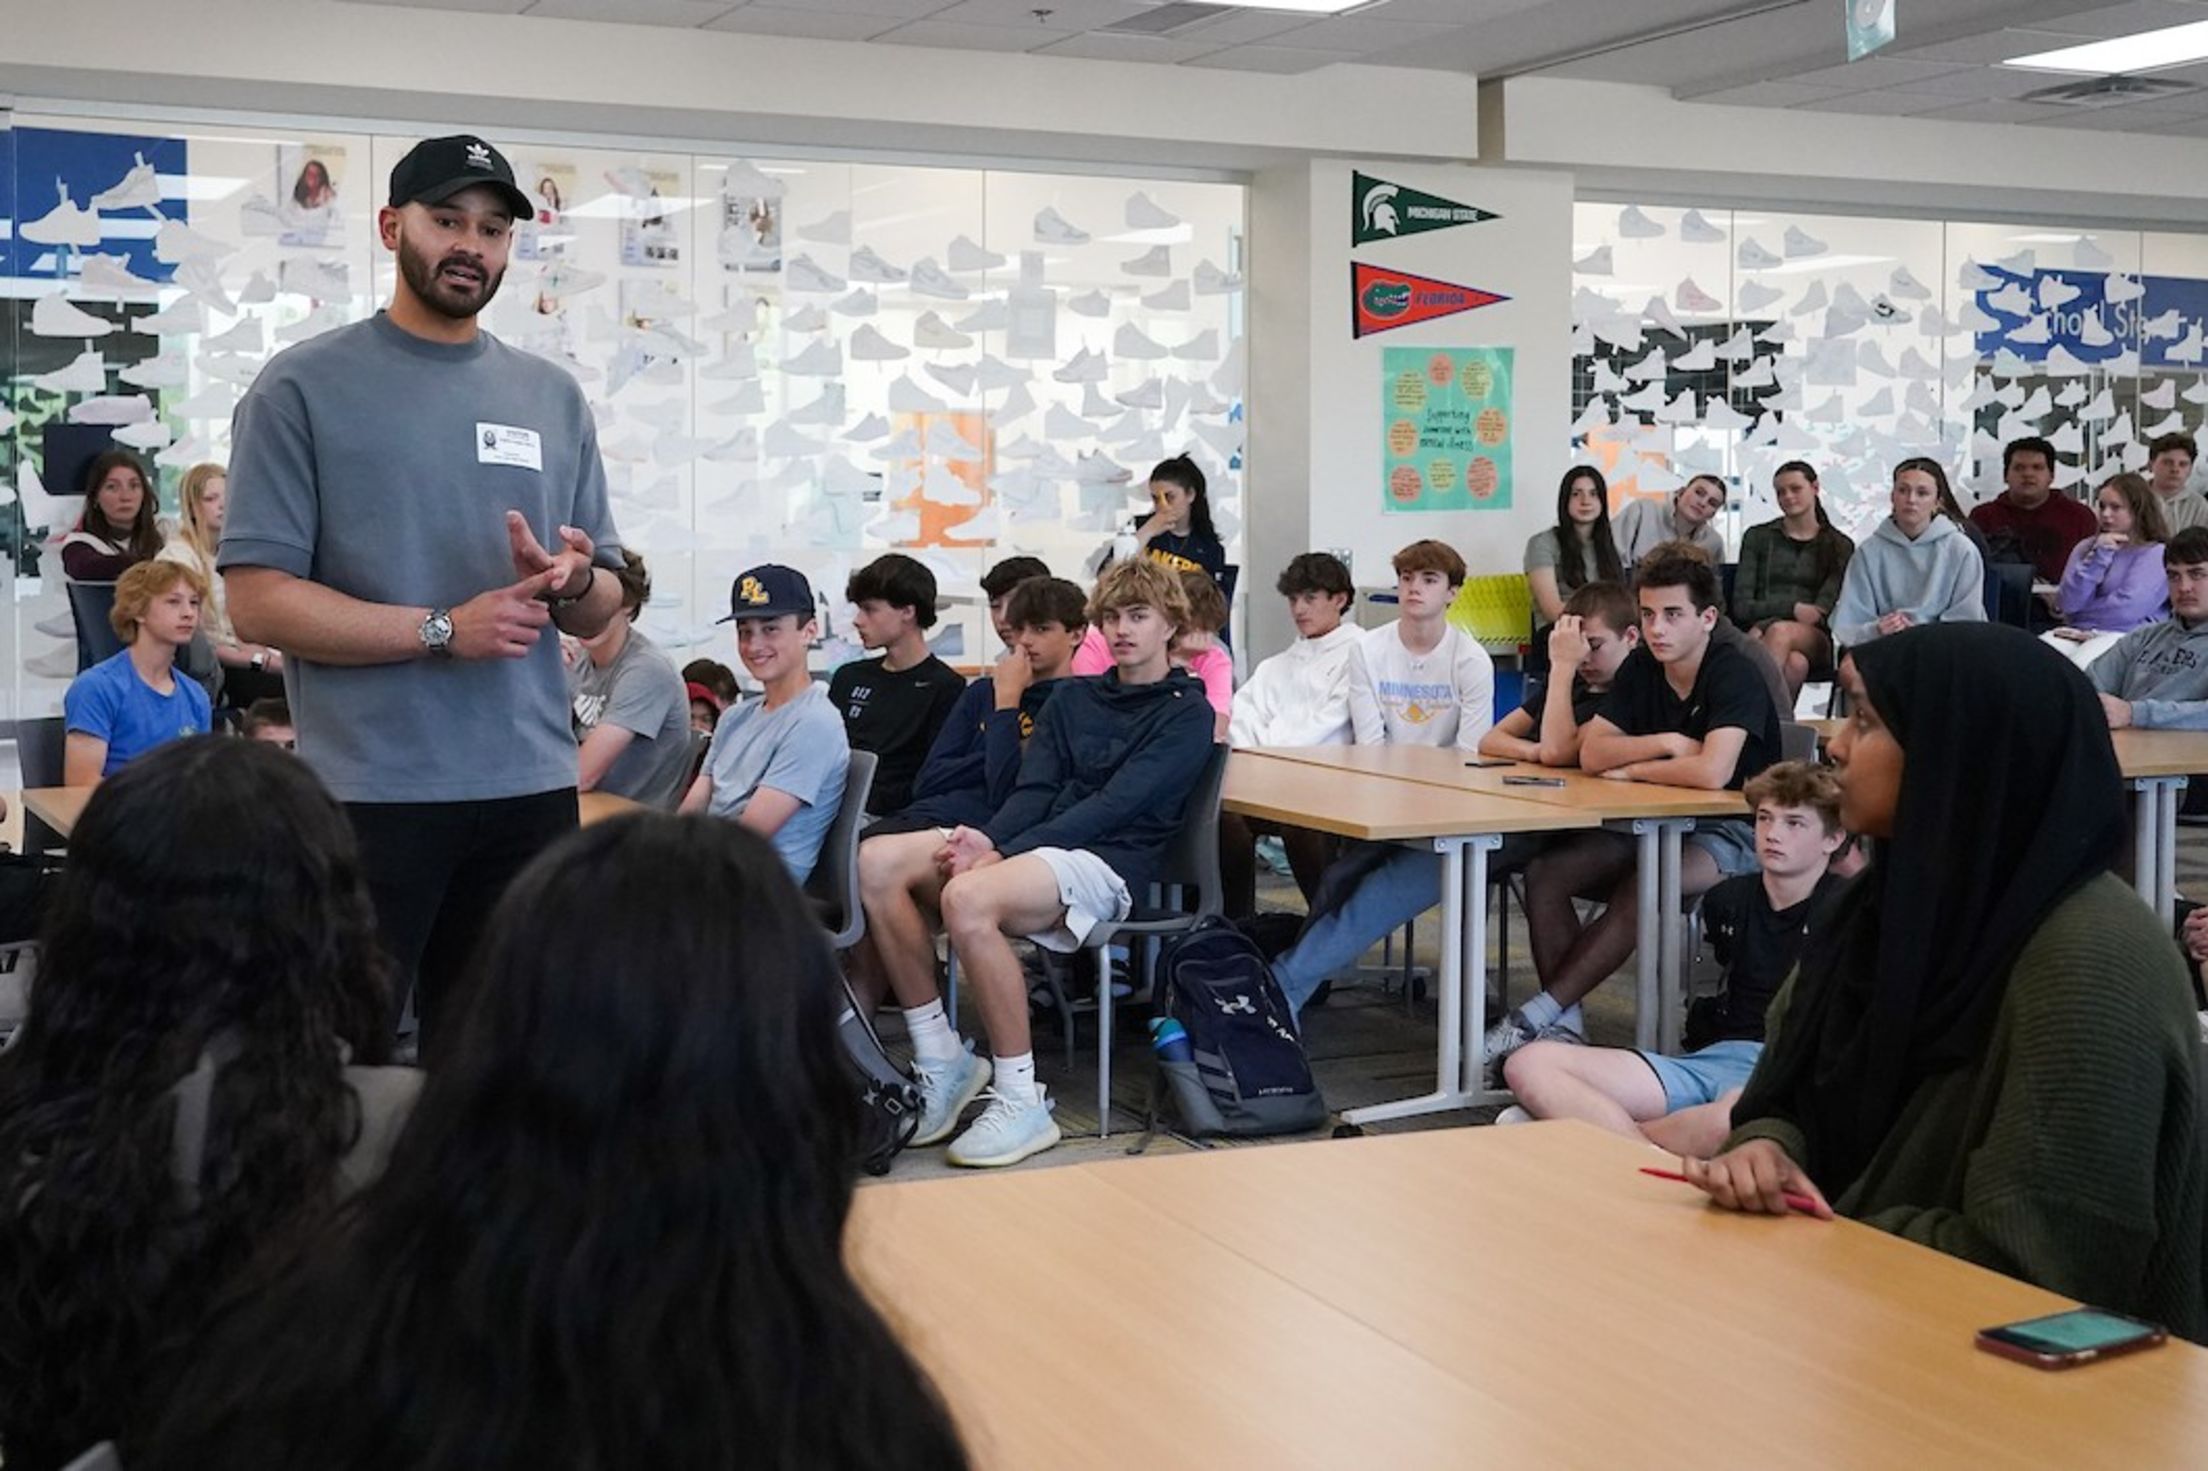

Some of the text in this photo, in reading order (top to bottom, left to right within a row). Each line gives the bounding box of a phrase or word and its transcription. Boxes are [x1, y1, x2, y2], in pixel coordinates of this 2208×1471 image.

[1407, 206, 1479, 222] MICHIGAN STATE
[1416, 291, 1466, 305] FLORIDA
[1379, 681, 1453, 700] MINNESOTA
